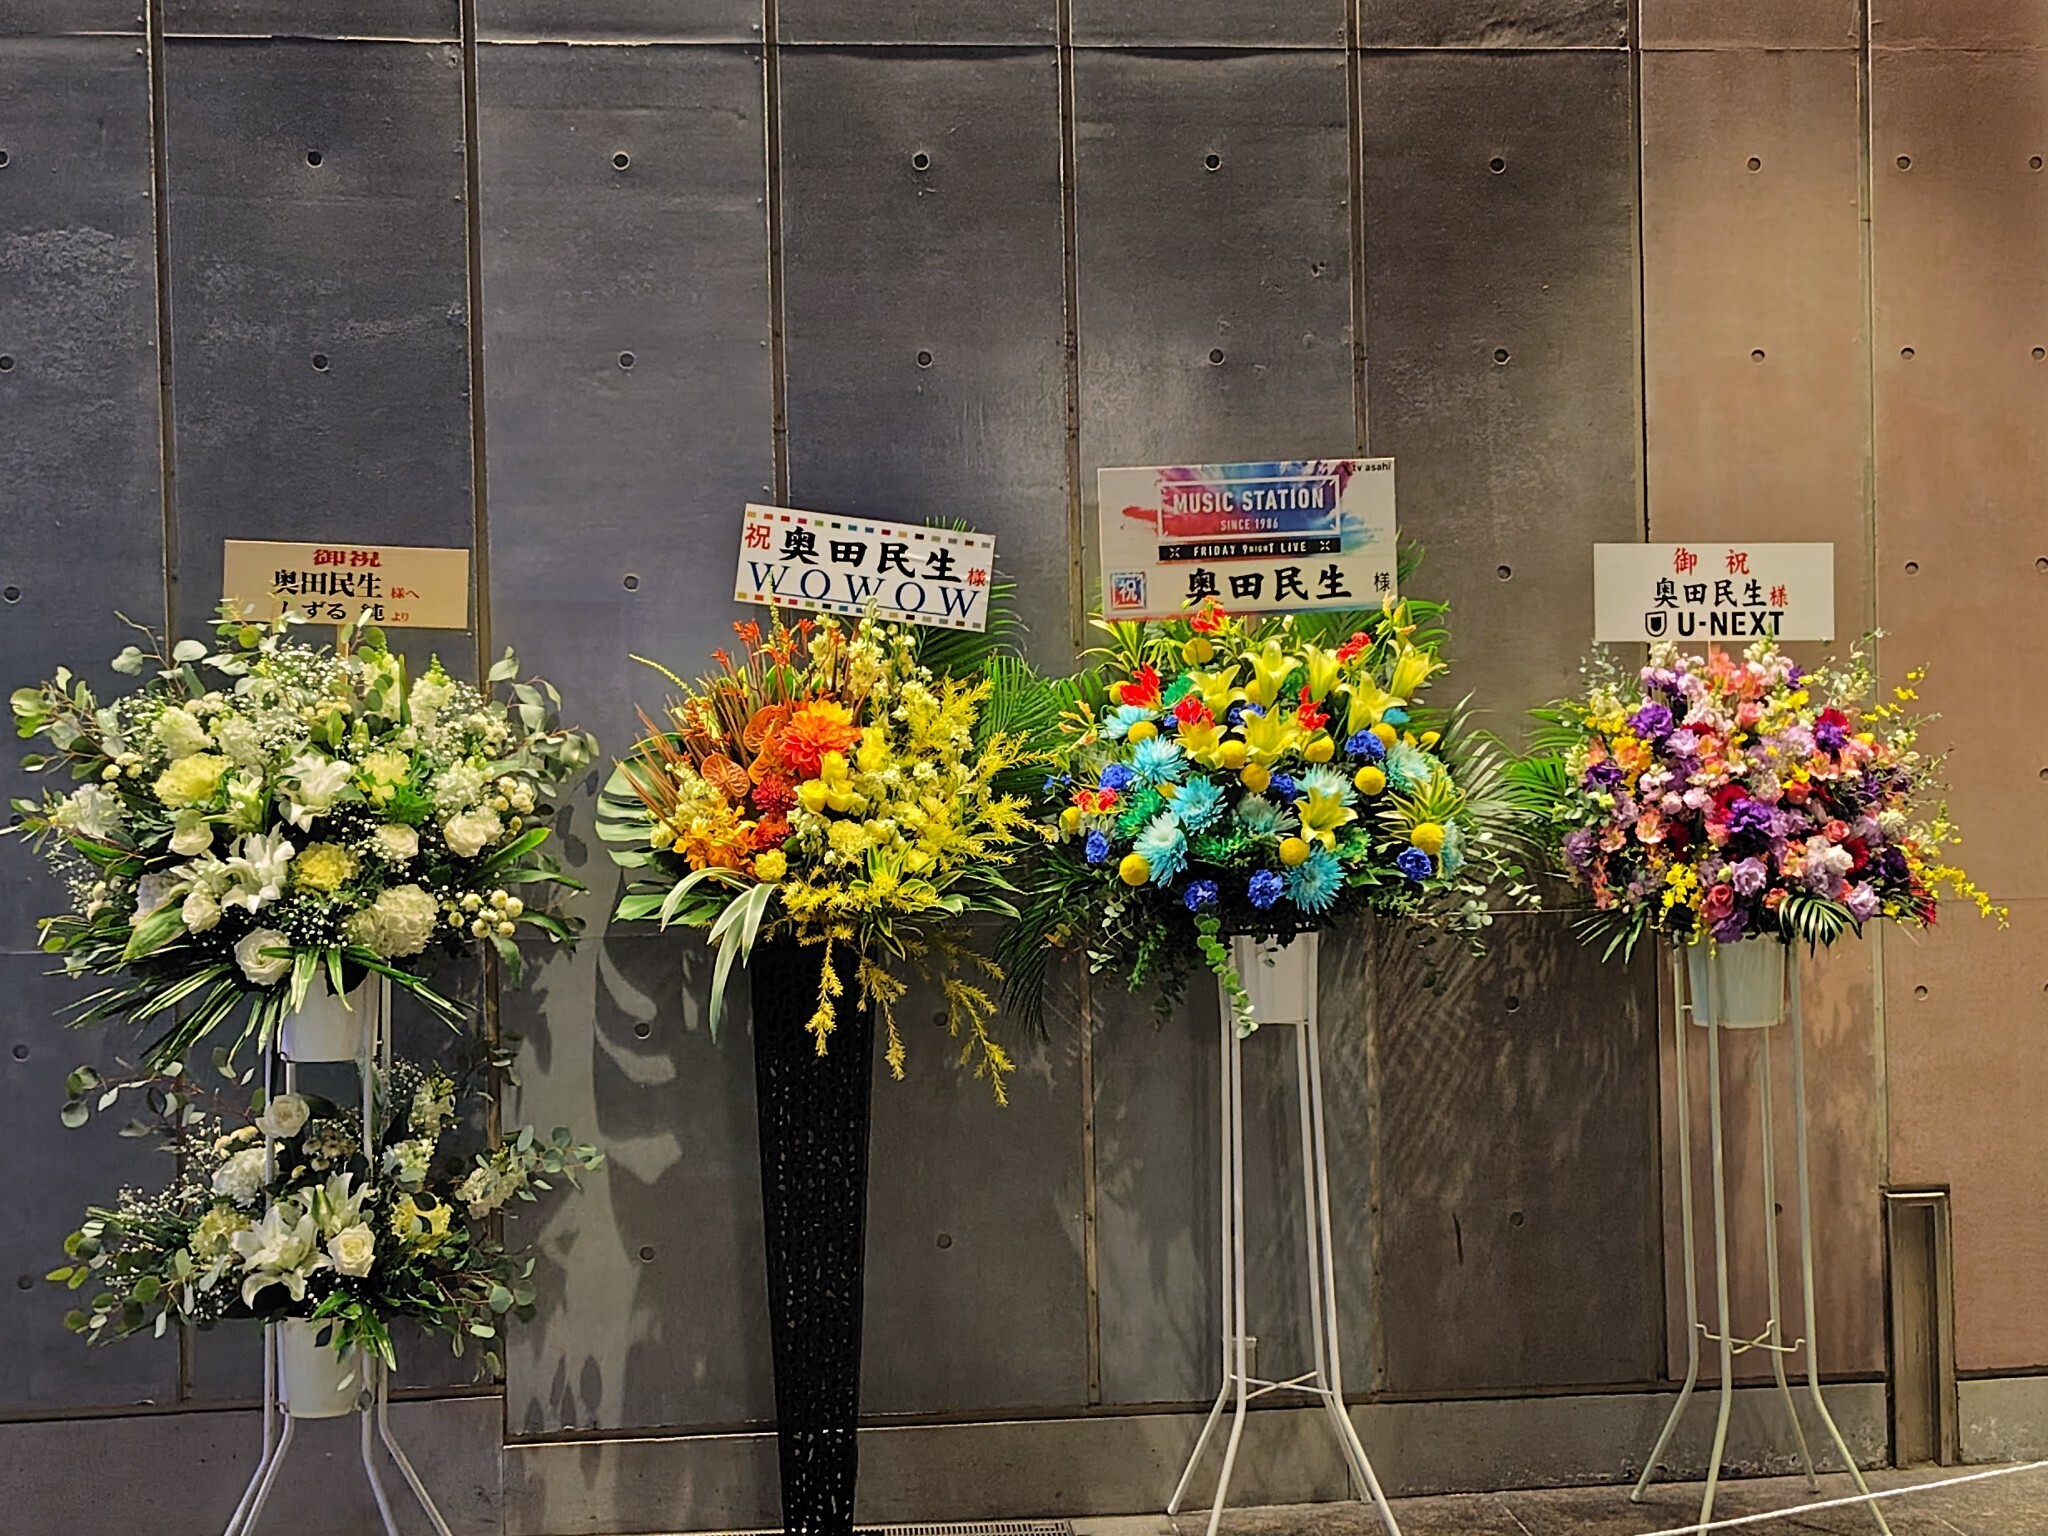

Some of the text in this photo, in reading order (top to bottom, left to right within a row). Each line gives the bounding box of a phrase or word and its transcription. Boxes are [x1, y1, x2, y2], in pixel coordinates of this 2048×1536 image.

[1365, 461, 1391, 471] asahi
[1173, 487, 1324, 514] MUSIC STATION
[744, 522, 771, 550] 祝
[1220, 517, 1279, 531] SINCE 1986
[312, 548, 382, 567] 御祝
[1193, 544, 1236, 557] FRIDAY
[1280, 541, 1307, 553] LIVE
[273, 568, 384, 598] 奥田民生
[747, 560, 981, 619] WOWOW
[1117, 580, 1138, 601] 祝
[1185, 563, 1353, 605] 奥田民生
[1677, 611, 1784, 636] U-NEXT
